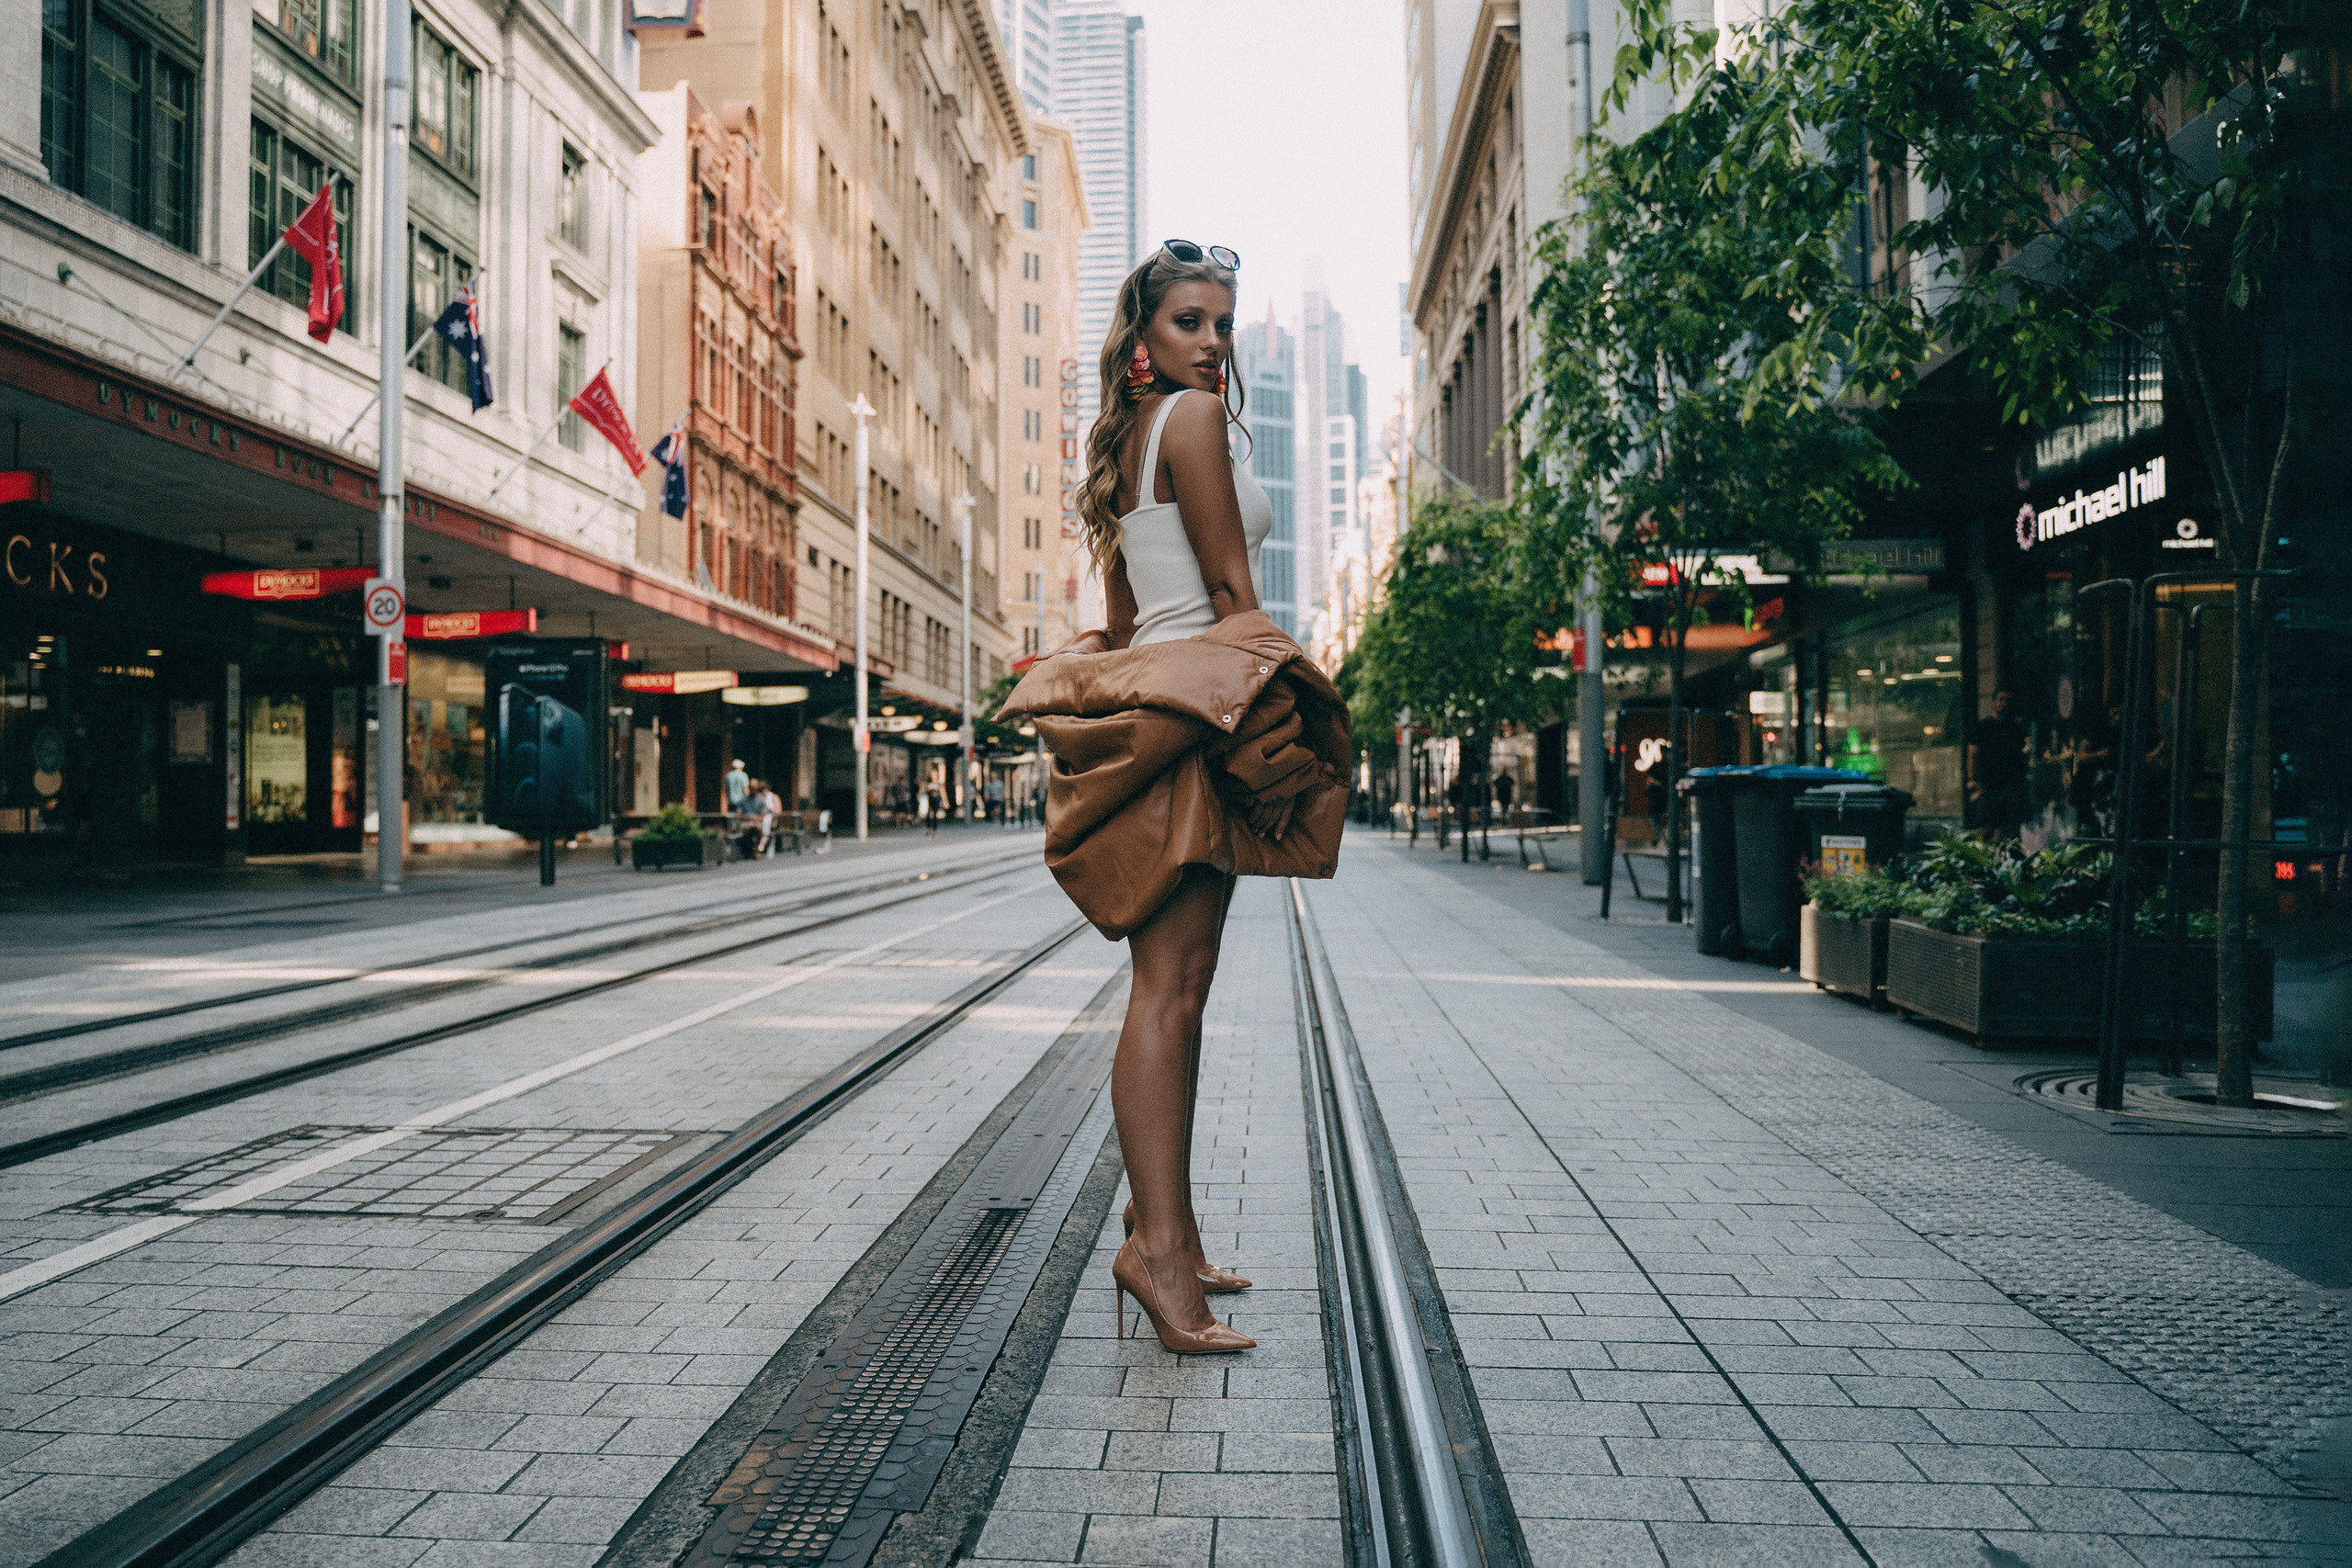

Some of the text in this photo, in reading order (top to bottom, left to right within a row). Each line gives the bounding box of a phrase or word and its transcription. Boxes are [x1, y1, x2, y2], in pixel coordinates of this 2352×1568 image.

[97, 380, 240, 452] DYMOCKS
[2038, 456, 2166, 542] michael hill
[374, 597, 396, 615] 20
